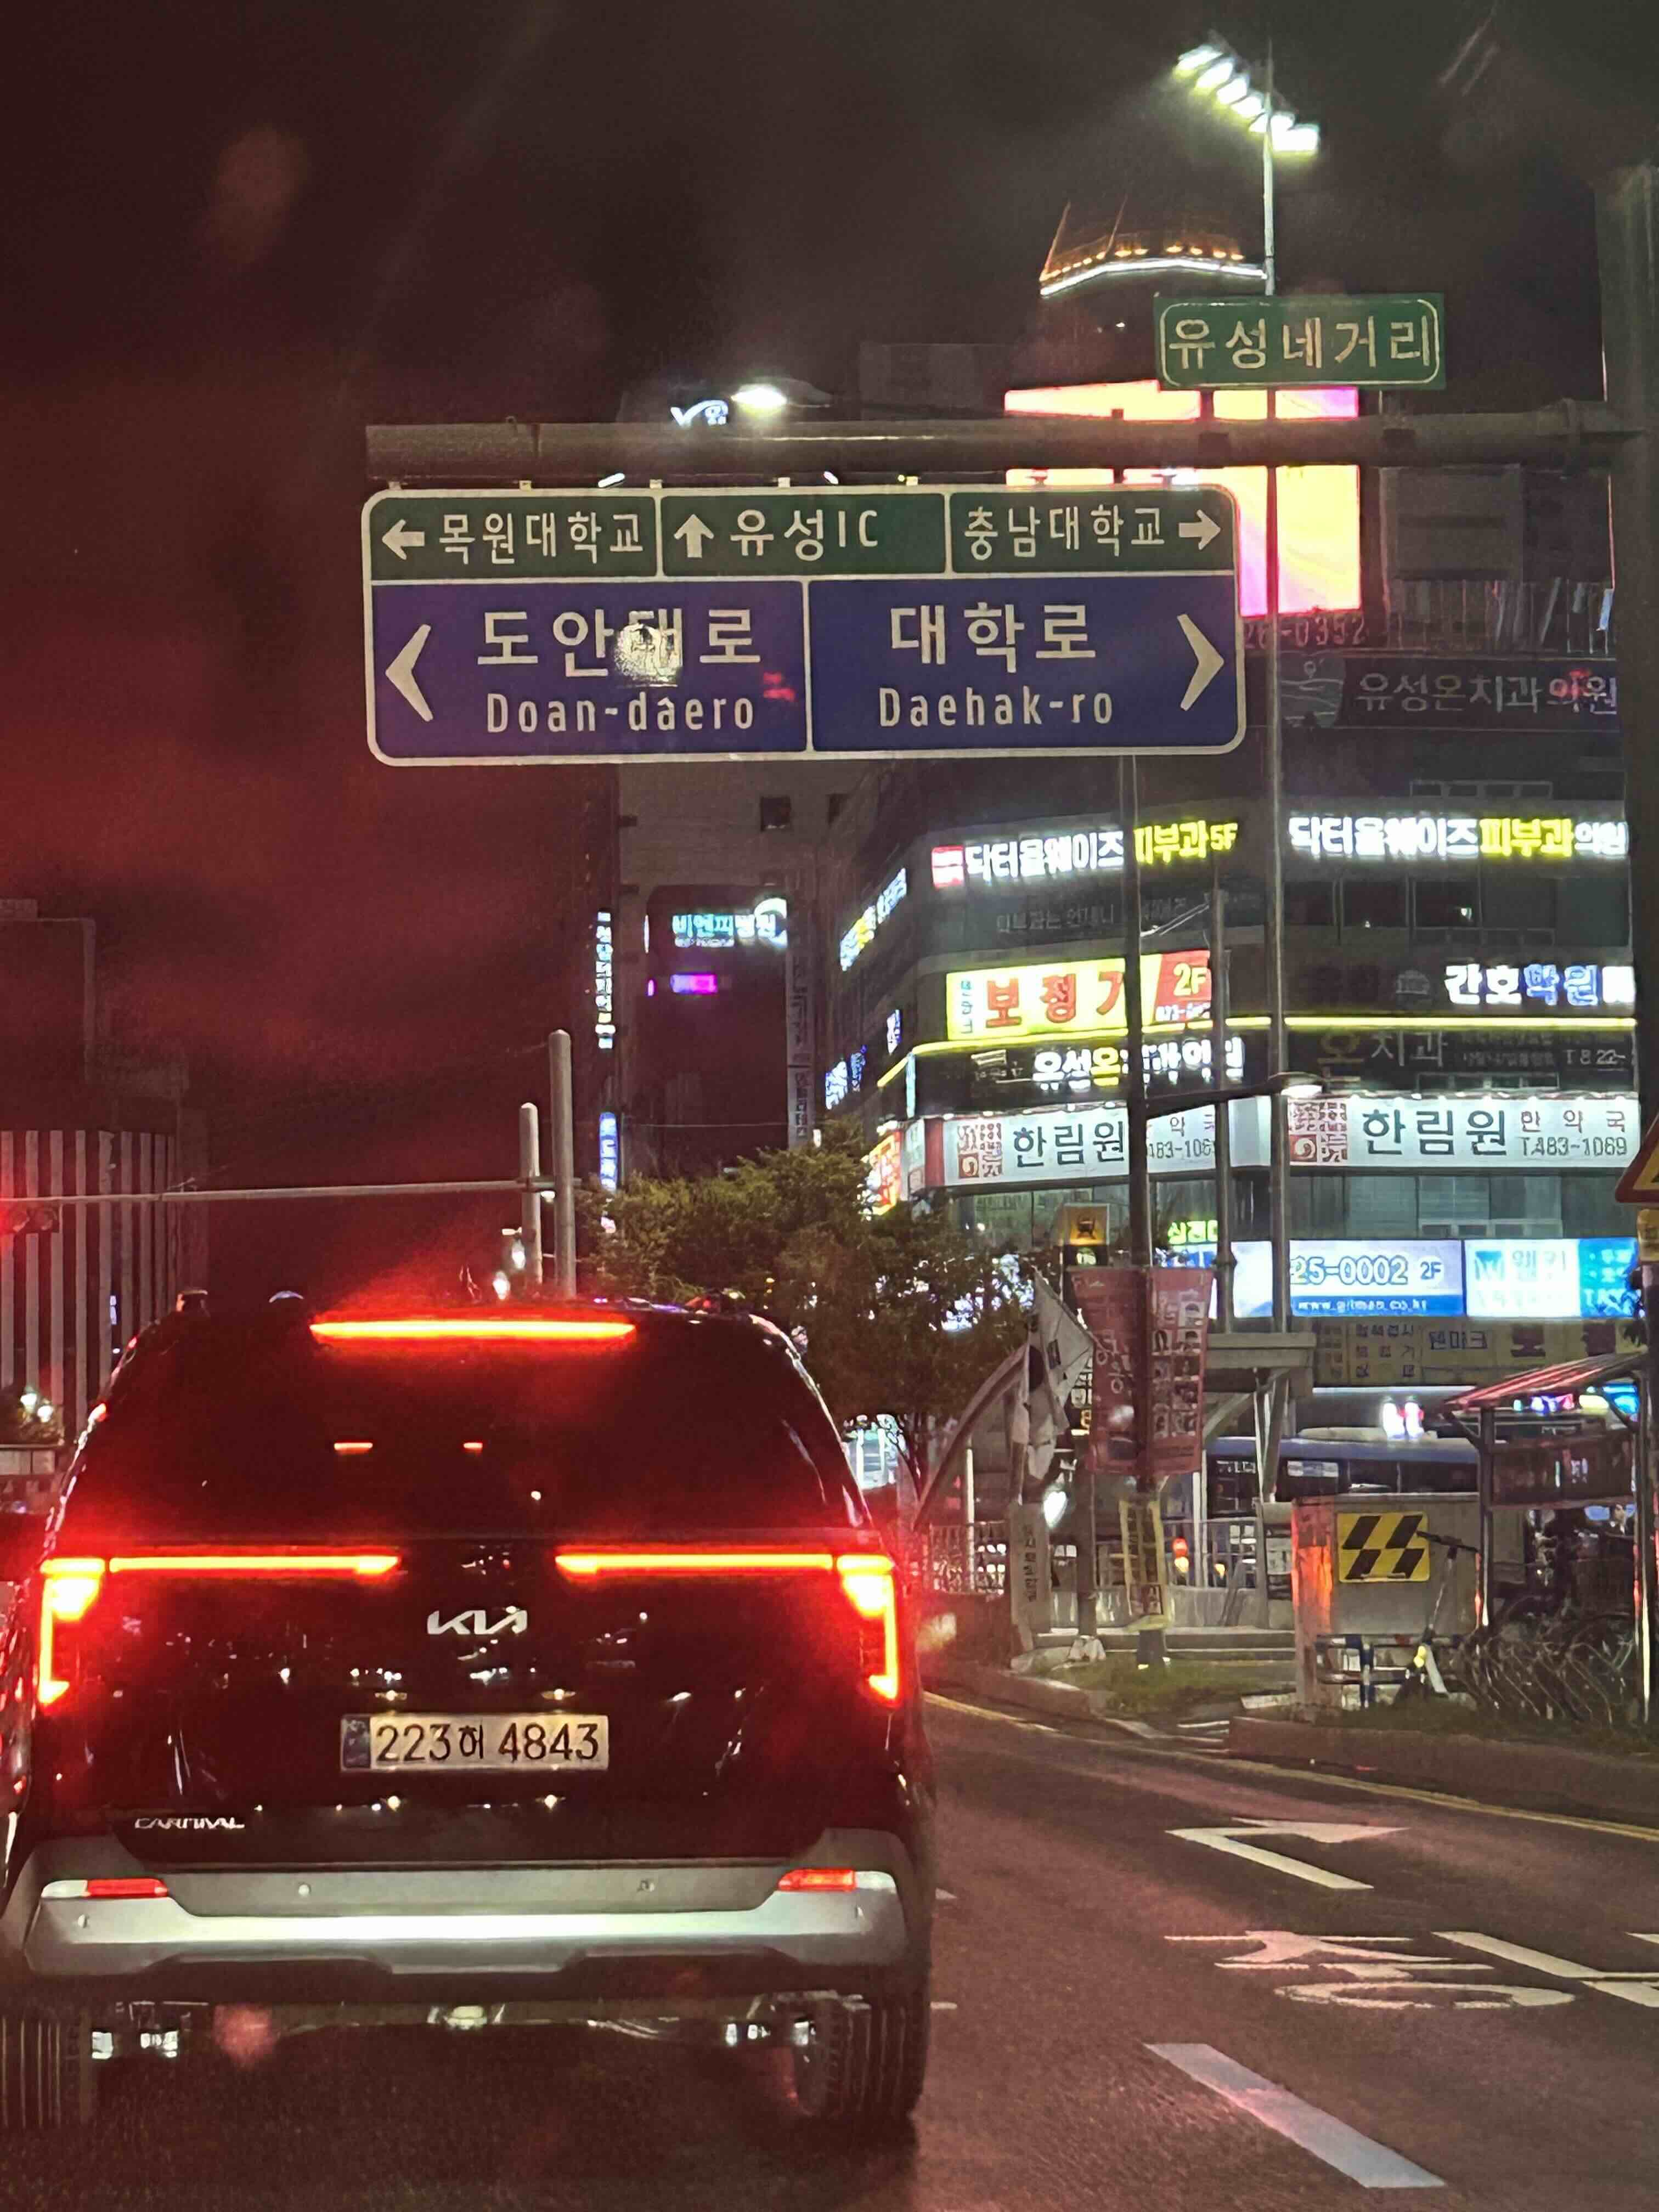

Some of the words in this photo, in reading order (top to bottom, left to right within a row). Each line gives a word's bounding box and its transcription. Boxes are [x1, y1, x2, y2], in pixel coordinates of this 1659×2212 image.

[1169, 315, 1430, 369] 유성네거리
[439, 511, 644, 564] 목원대학교
[730, 508, 878, 562] 유성IC
[964, 505, 1165, 561] 충남대학교
[477, 608, 761, 678] 도안대로
[890, 602, 1096, 673] 대학로
[487, 692, 754, 733] Doan-daero
[879, 686, 1113, 727] Daehak-ro
[1172, 963, 1207, 996] 2F
[1013, 1121, 1124, 1168] 한림원
[1363, 1109, 1508, 1156] 한림원
[1421, 1261, 1442, 1280] 2F
[427, 1610, 527, 1635] KIA
[376, 1720, 484, 1762] 223허
[498, 1722, 599, 1763] 4843
[134, 1817, 245, 1830] CARNIVAL
